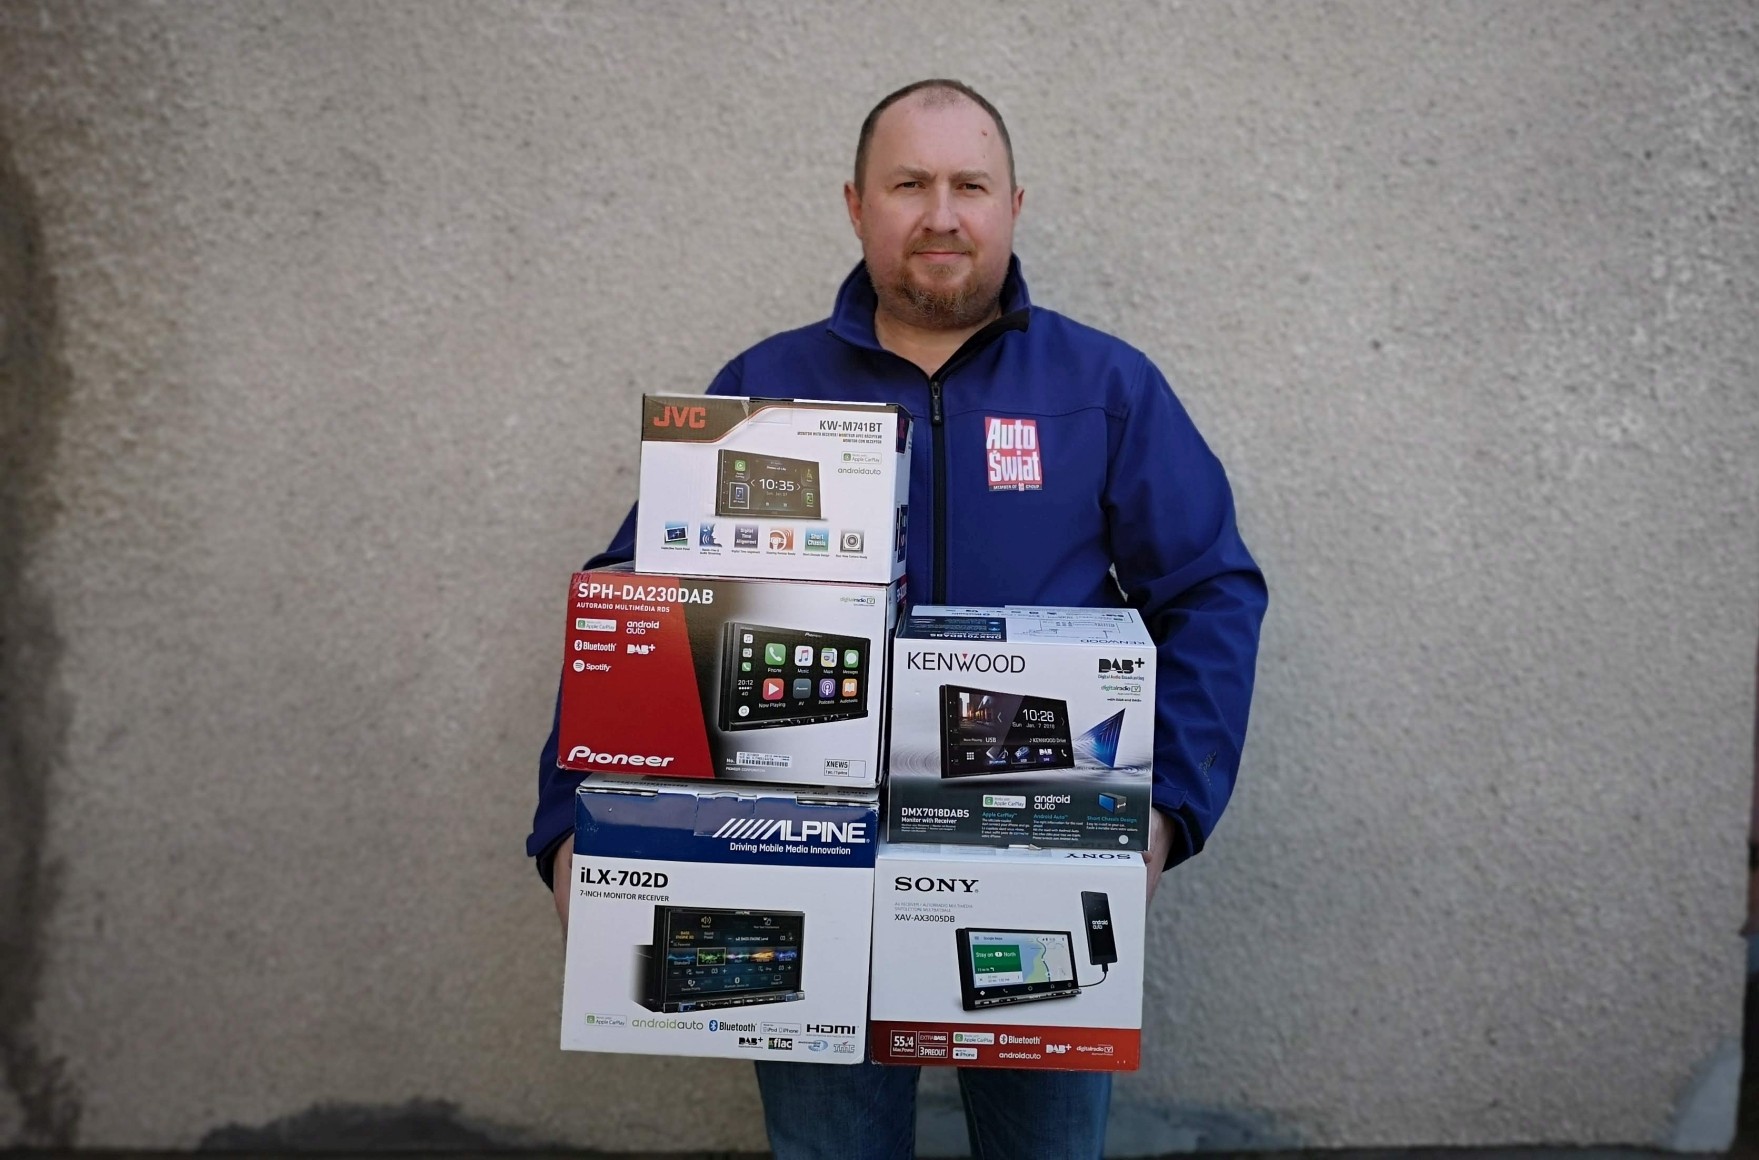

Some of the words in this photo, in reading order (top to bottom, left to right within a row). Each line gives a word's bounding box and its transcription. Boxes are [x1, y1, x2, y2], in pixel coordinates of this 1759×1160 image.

[654, 406, 706, 429] JVC
[819, 420, 882, 432] KW-M741BT
[986, 418, 1036, 450] Auto
[989, 450, 1041, 482] Świat
[759, 478, 794, 491] 10:35
[577, 582, 714, 605] SPH-DA230DAB
[577, 602, 613, 610] AUTORADIO
[627, 620, 659, 629] android
[583, 641, 615, 652] Bluetooth
[586, 663, 612, 672] Spotify
[908, 651, 1026, 674] KENWOOD
[1099, 656, 1145, 674] DAB+
[1023, 709, 1054, 722] 10:28
[567, 746, 675, 767] Pioneer
[1034, 794, 1071, 804] android
[901, 807, 970, 818] DMX7018DABS
[1034, 803, 1056, 811] auto
[764, 818, 868, 843] ALPINE
[730, 841, 758, 853] Driving
[760, 843, 785, 854] Mobile
[786, 844, 809, 855] Media
[810, 845, 852, 856] Innovation
[580, 867, 670, 889] iLX-702D
[895, 876, 979, 893] SONY
[579, 890, 602, 898] 7-INCH
[604, 891, 637, 900] MONITOR
[638, 893, 671, 902] RECEIVER
[894, 914, 955, 923] XAV-AX3005DB
[976, 951, 986, 960] Stay
[632, 1018, 704, 1031] androidauto
[719, 1021, 756, 1033] Bluetooth
[806, 1023, 856, 1035] HDMI
[738, 1036, 764, 1046] DAB+
[774, 1038, 792, 1049] flac
[1008, 1035, 1041, 1045] Bluetooth
[999, 1051, 1041, 1061] androidauto
